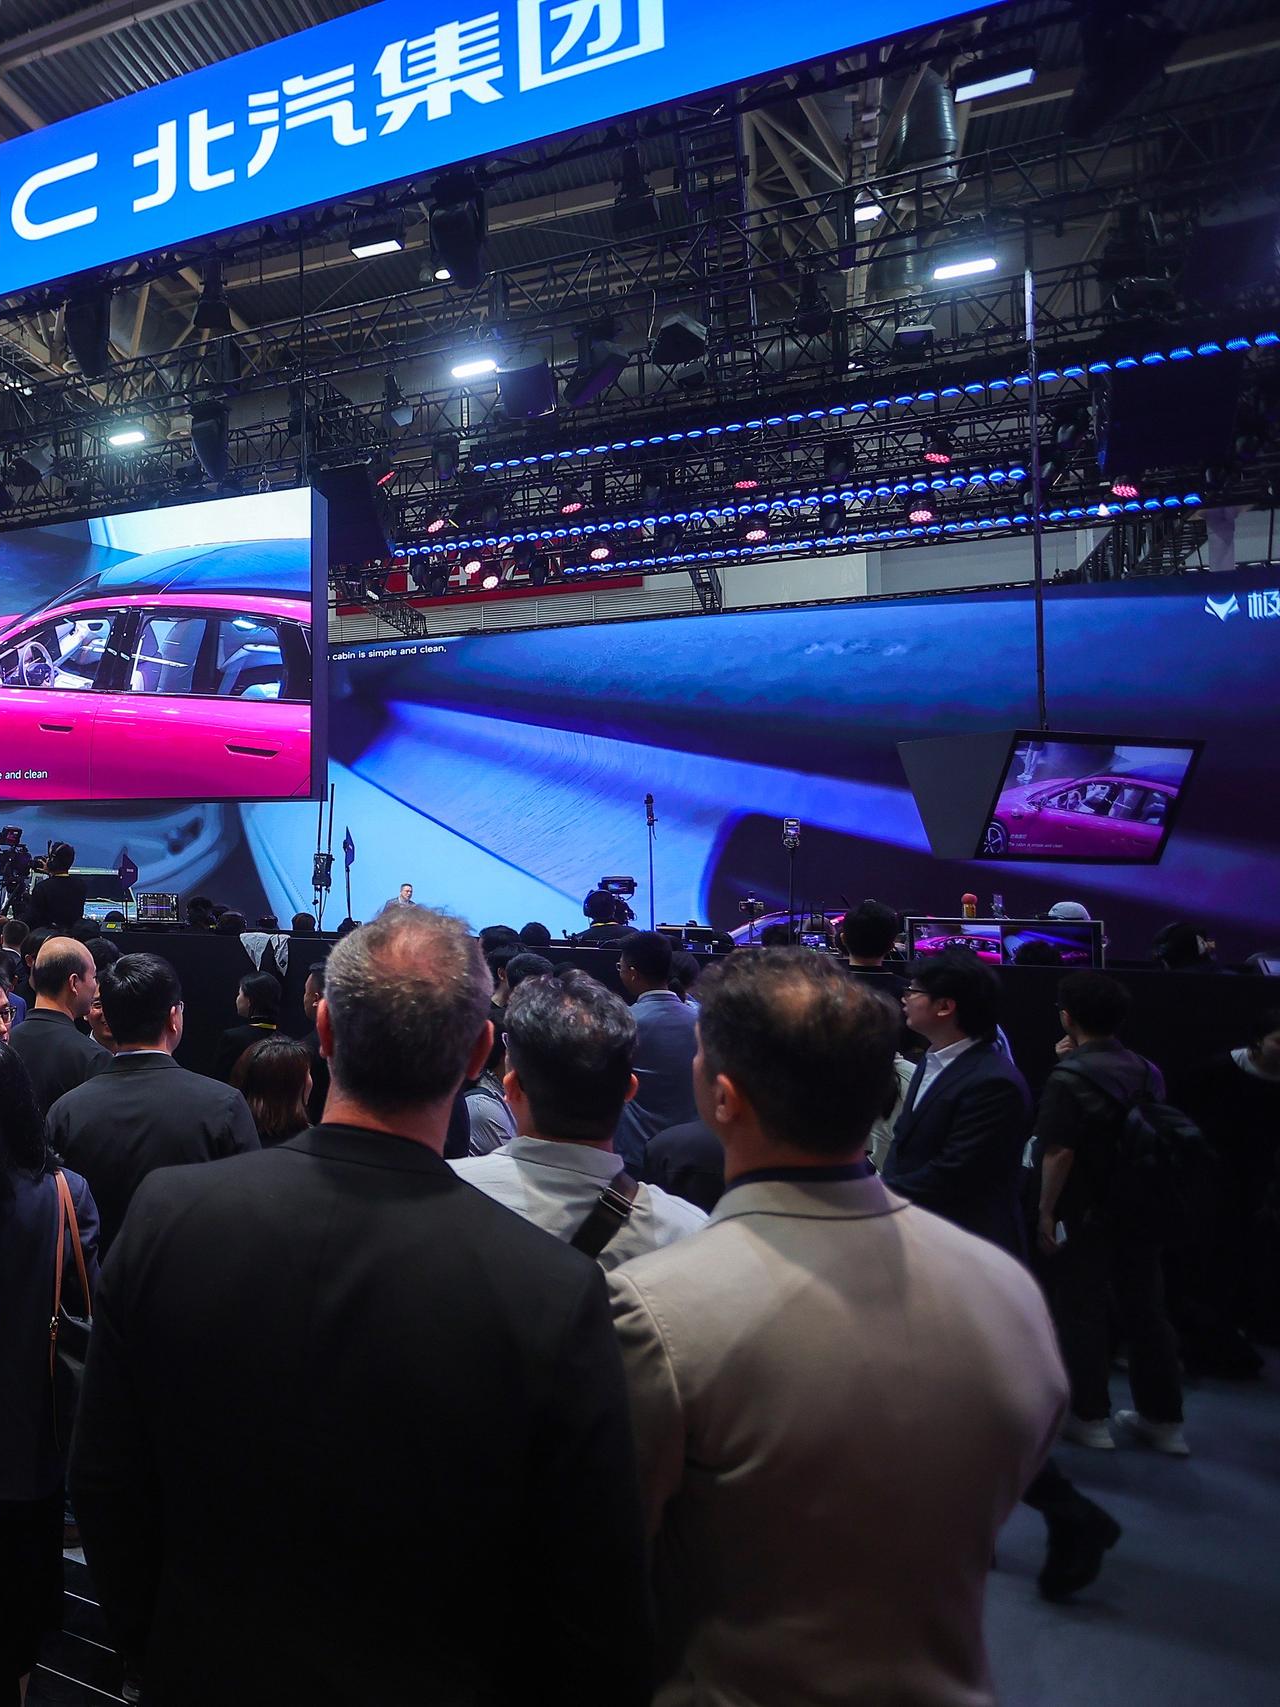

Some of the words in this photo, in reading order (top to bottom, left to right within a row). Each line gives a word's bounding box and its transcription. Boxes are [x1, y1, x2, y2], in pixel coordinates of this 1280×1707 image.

[132, 0, 665, 213] 北汽集团
[332, 652, 356, 661] cabin
[358, 650, 366, 658] is
[368, 648, 397, 659] simple
[400, 646, 417, 655] and
[5, 770, 21, 779] and
[24, 769, 48, 779] clean
